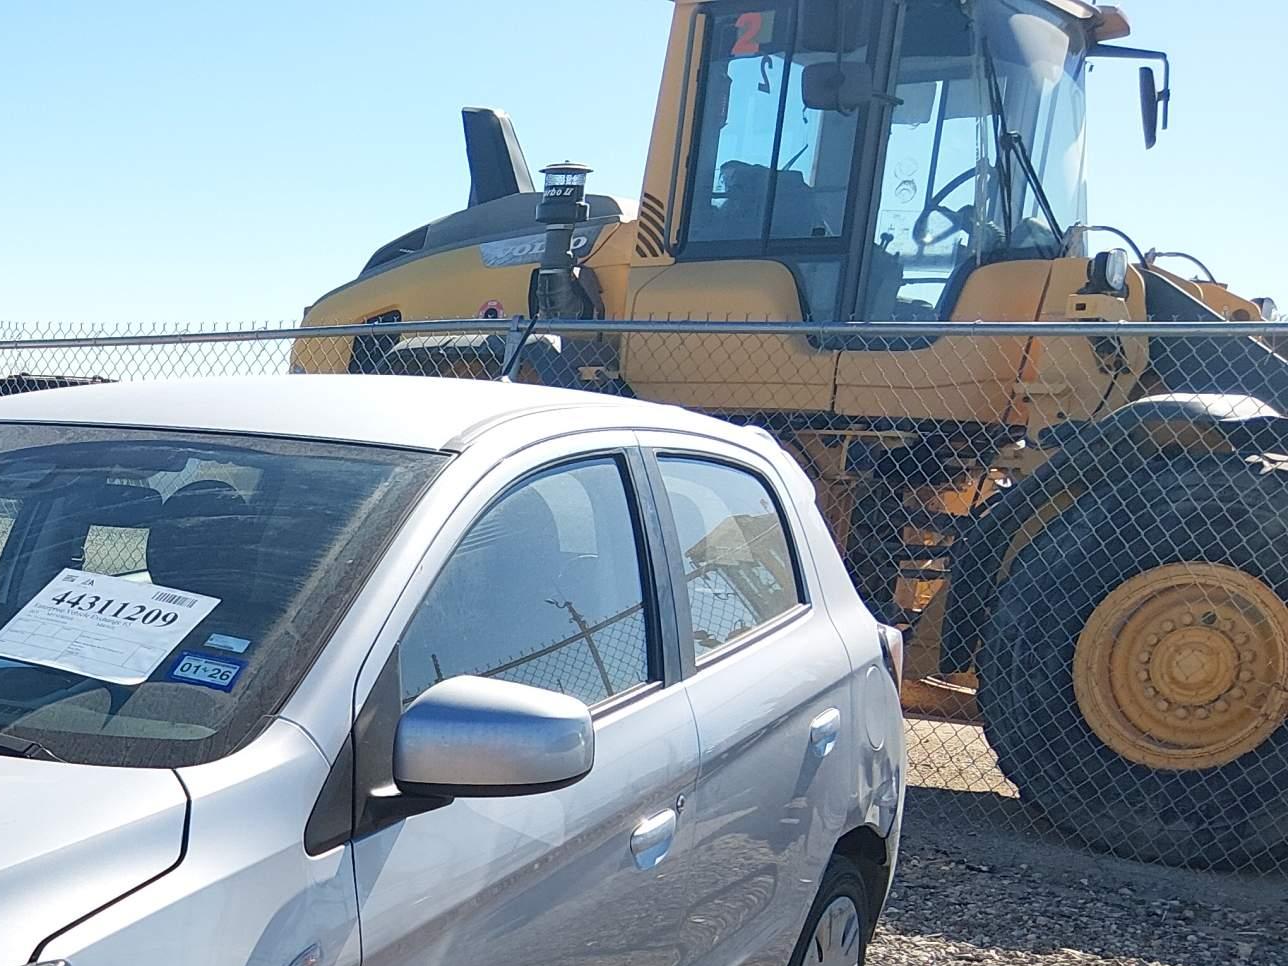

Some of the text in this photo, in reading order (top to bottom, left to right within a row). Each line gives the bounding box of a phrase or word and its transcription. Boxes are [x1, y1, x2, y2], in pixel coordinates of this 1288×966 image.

[731, 11, 762, 55] 2
[51, 590, 179, 628] 44311209
[179, 662, 201, 675] 01
[207, 668, 232, 681] 26
